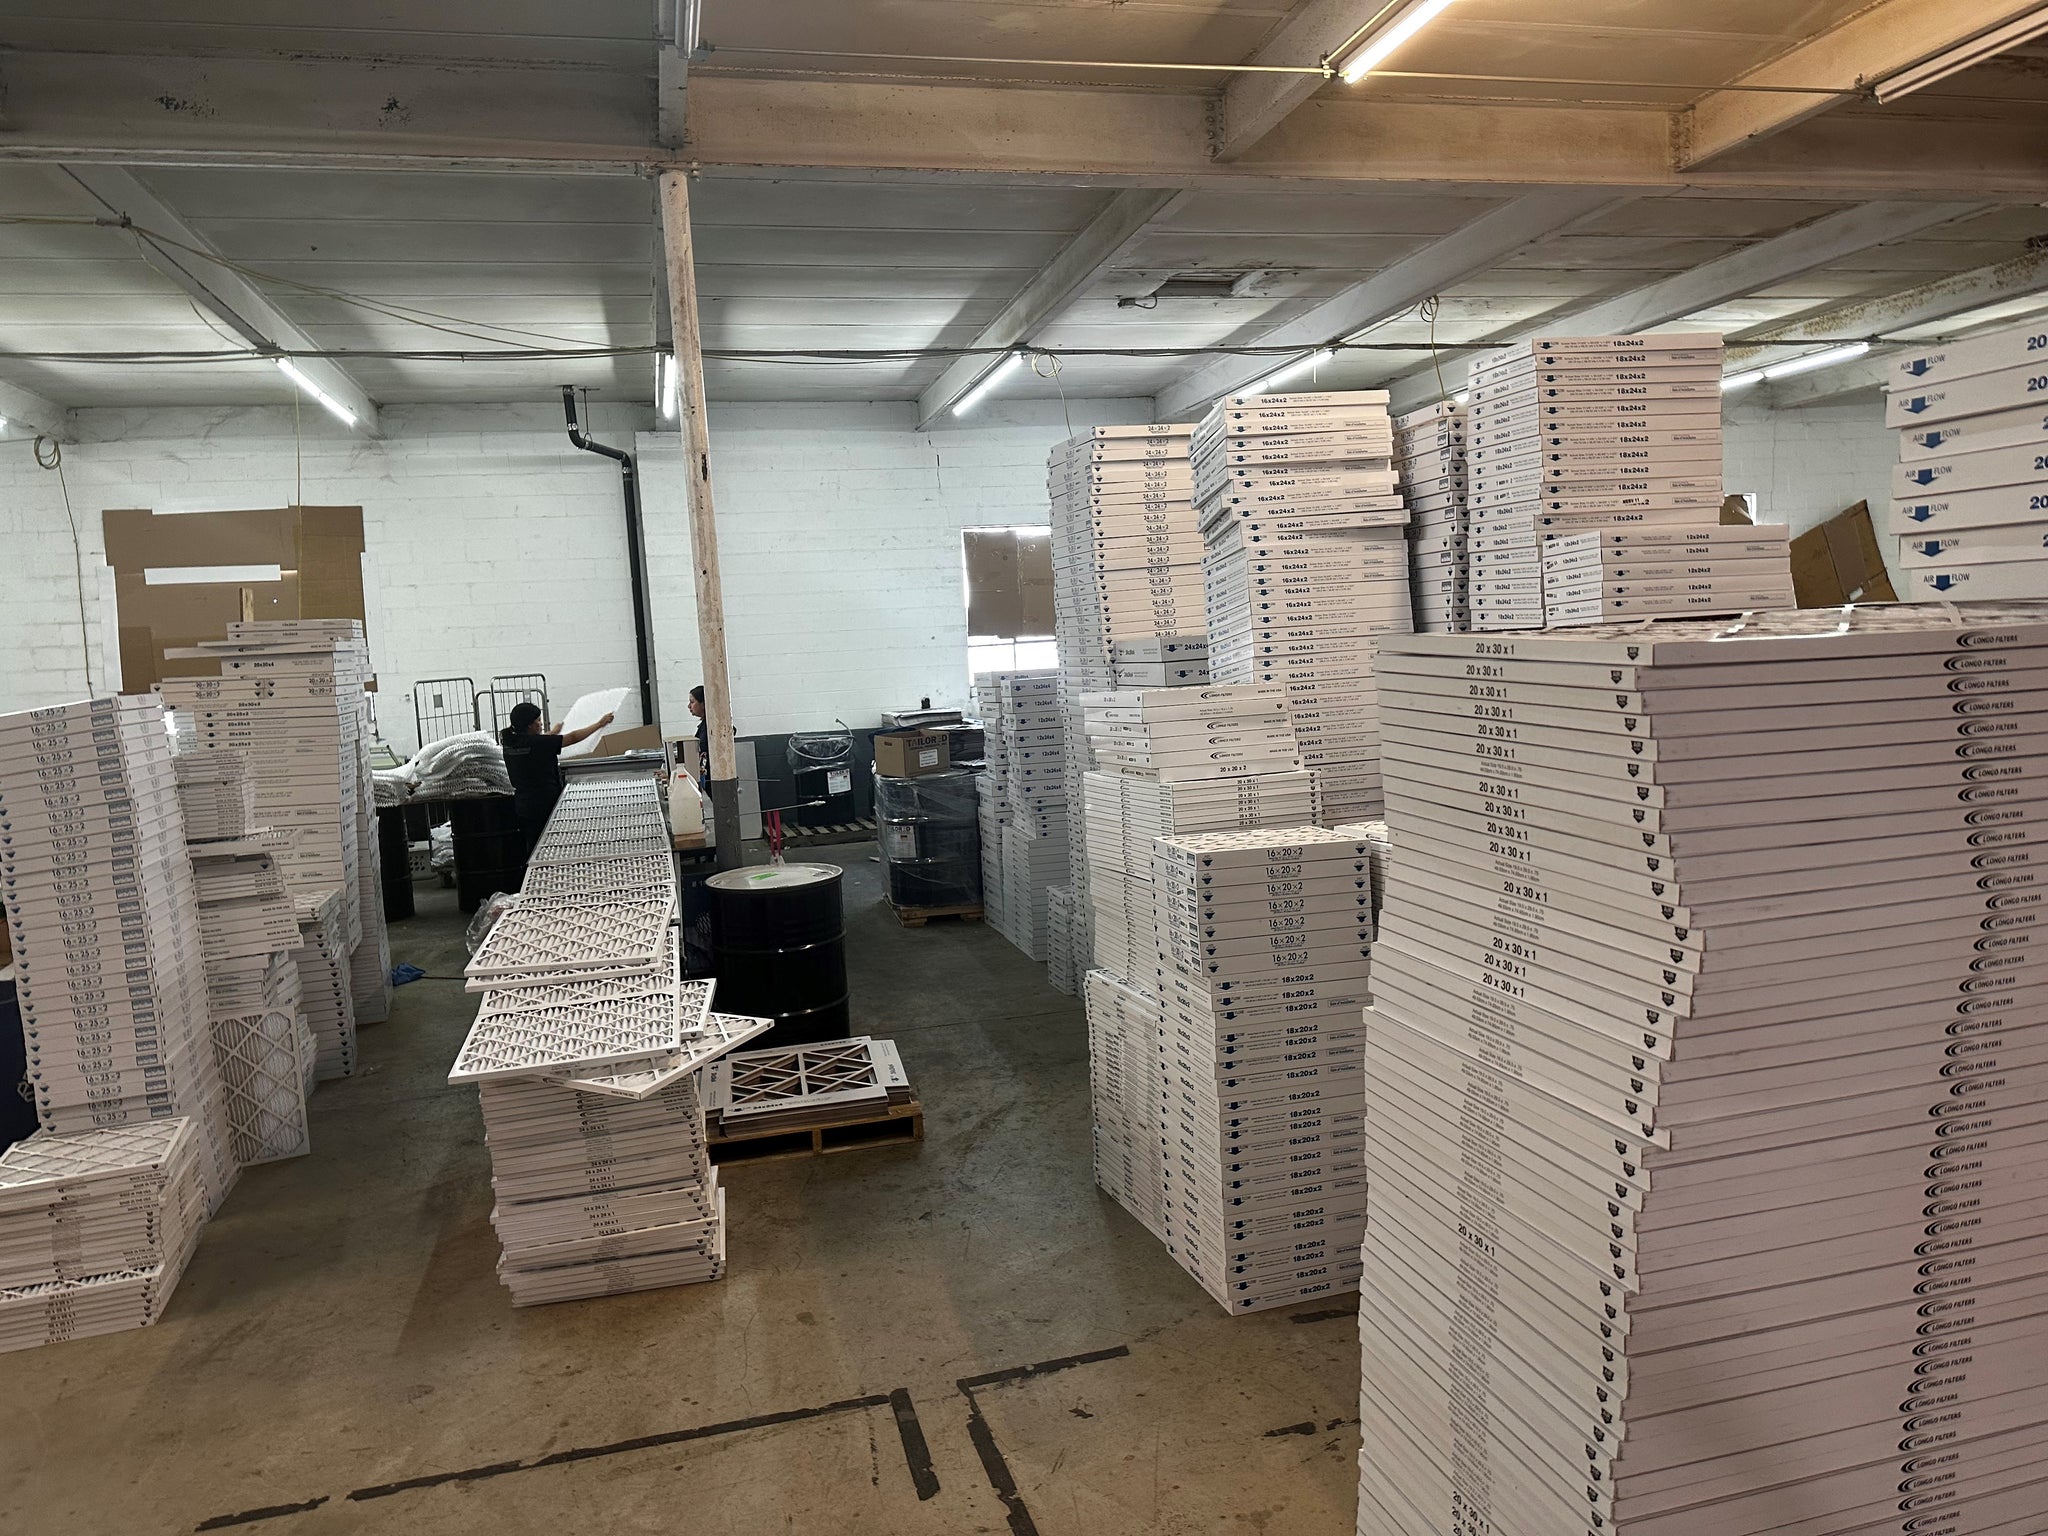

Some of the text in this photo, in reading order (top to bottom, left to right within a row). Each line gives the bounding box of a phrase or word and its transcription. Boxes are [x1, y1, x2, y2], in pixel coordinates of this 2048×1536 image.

[2027, 334, 2047, 351] 20
[1616, 355, 1646, 363] 18x24x2
[1900, 354, 1946, 370] AIR FLOW
[2027, 375, 2048, 392] 20
[1617, 387, 1647, 395] 18x24x2
[1899, 392, 1946, 408] AIR FLOW
[1913, 428, 1961, 442] AIR FLOW
[1905, 466, 1952, 478] AIR FLOW
[1902, 503, 1949, 514] AIR FLOW
[1912, 539, 1960, 549] AIR FLOW
[1951, 573, 1970, 581] FLOW
[1995, 635, 2018, 643] FILTERS
[1476, 643, 1484, 653] 20
[1492, 644, 1501, 654] 30
[1984, 658, 2006, 666] FILTERS
[1466, 665, 1475, 675] 20
[1482, 665, 1491, 676] 30
[1493, 668, 1497, 676] x
[1991, 701, 2014, 709] FILTERS
[1996, 723, 2018, 731] FILTERS
[2000, 766, 2022, 775] FILTERS
[2007, 853, 2029, 862] FILTERS
[1504, 881, 1514, 893] 20
[1516, 886, 1521, 894] x
[1523, 887, 1533, 898] 30
[1535, 892, 1540, 900] x
[2021, 894, 2041, 903] FILTERS
[2004, 956, 2025, 965] FILTERS
[1282, 974, 1314, 983] 18x20x2
[1282, 989, 1314, 999] 18x20x2
[1286, 1003, 1317, 1012] 18x20x2
[1981, 1019, 2002, 1029] FILTERS
[1286, 1025, 1318, 1034] 18x20x2
[1285, 1037, 1317, 1046] 18x20x2
[1284, 1052, 1316, 1061] 18x20x2
[1286, 1069, 1318, 1078] 18x20x2
[1985, 1079, 2005, 1088] FILTERS
[1289, 1090, 1320, 1100] 18x20x2
[1290, 1108, 1321, 1117] 18x20x2
[1290, 1120, 1321, 1129] 18x20x2
[1289, 1135, 1320, 1145] 18x20x2
[1290, 1168, 1321, 1178] 18x20x2
[1459, 1223, 1466, 1236] 20
[1468, 1232, 1472, 1240] x
[1474, 1235, 1483, 1247] 30
[1485, 1243, 1489, 1252] x
